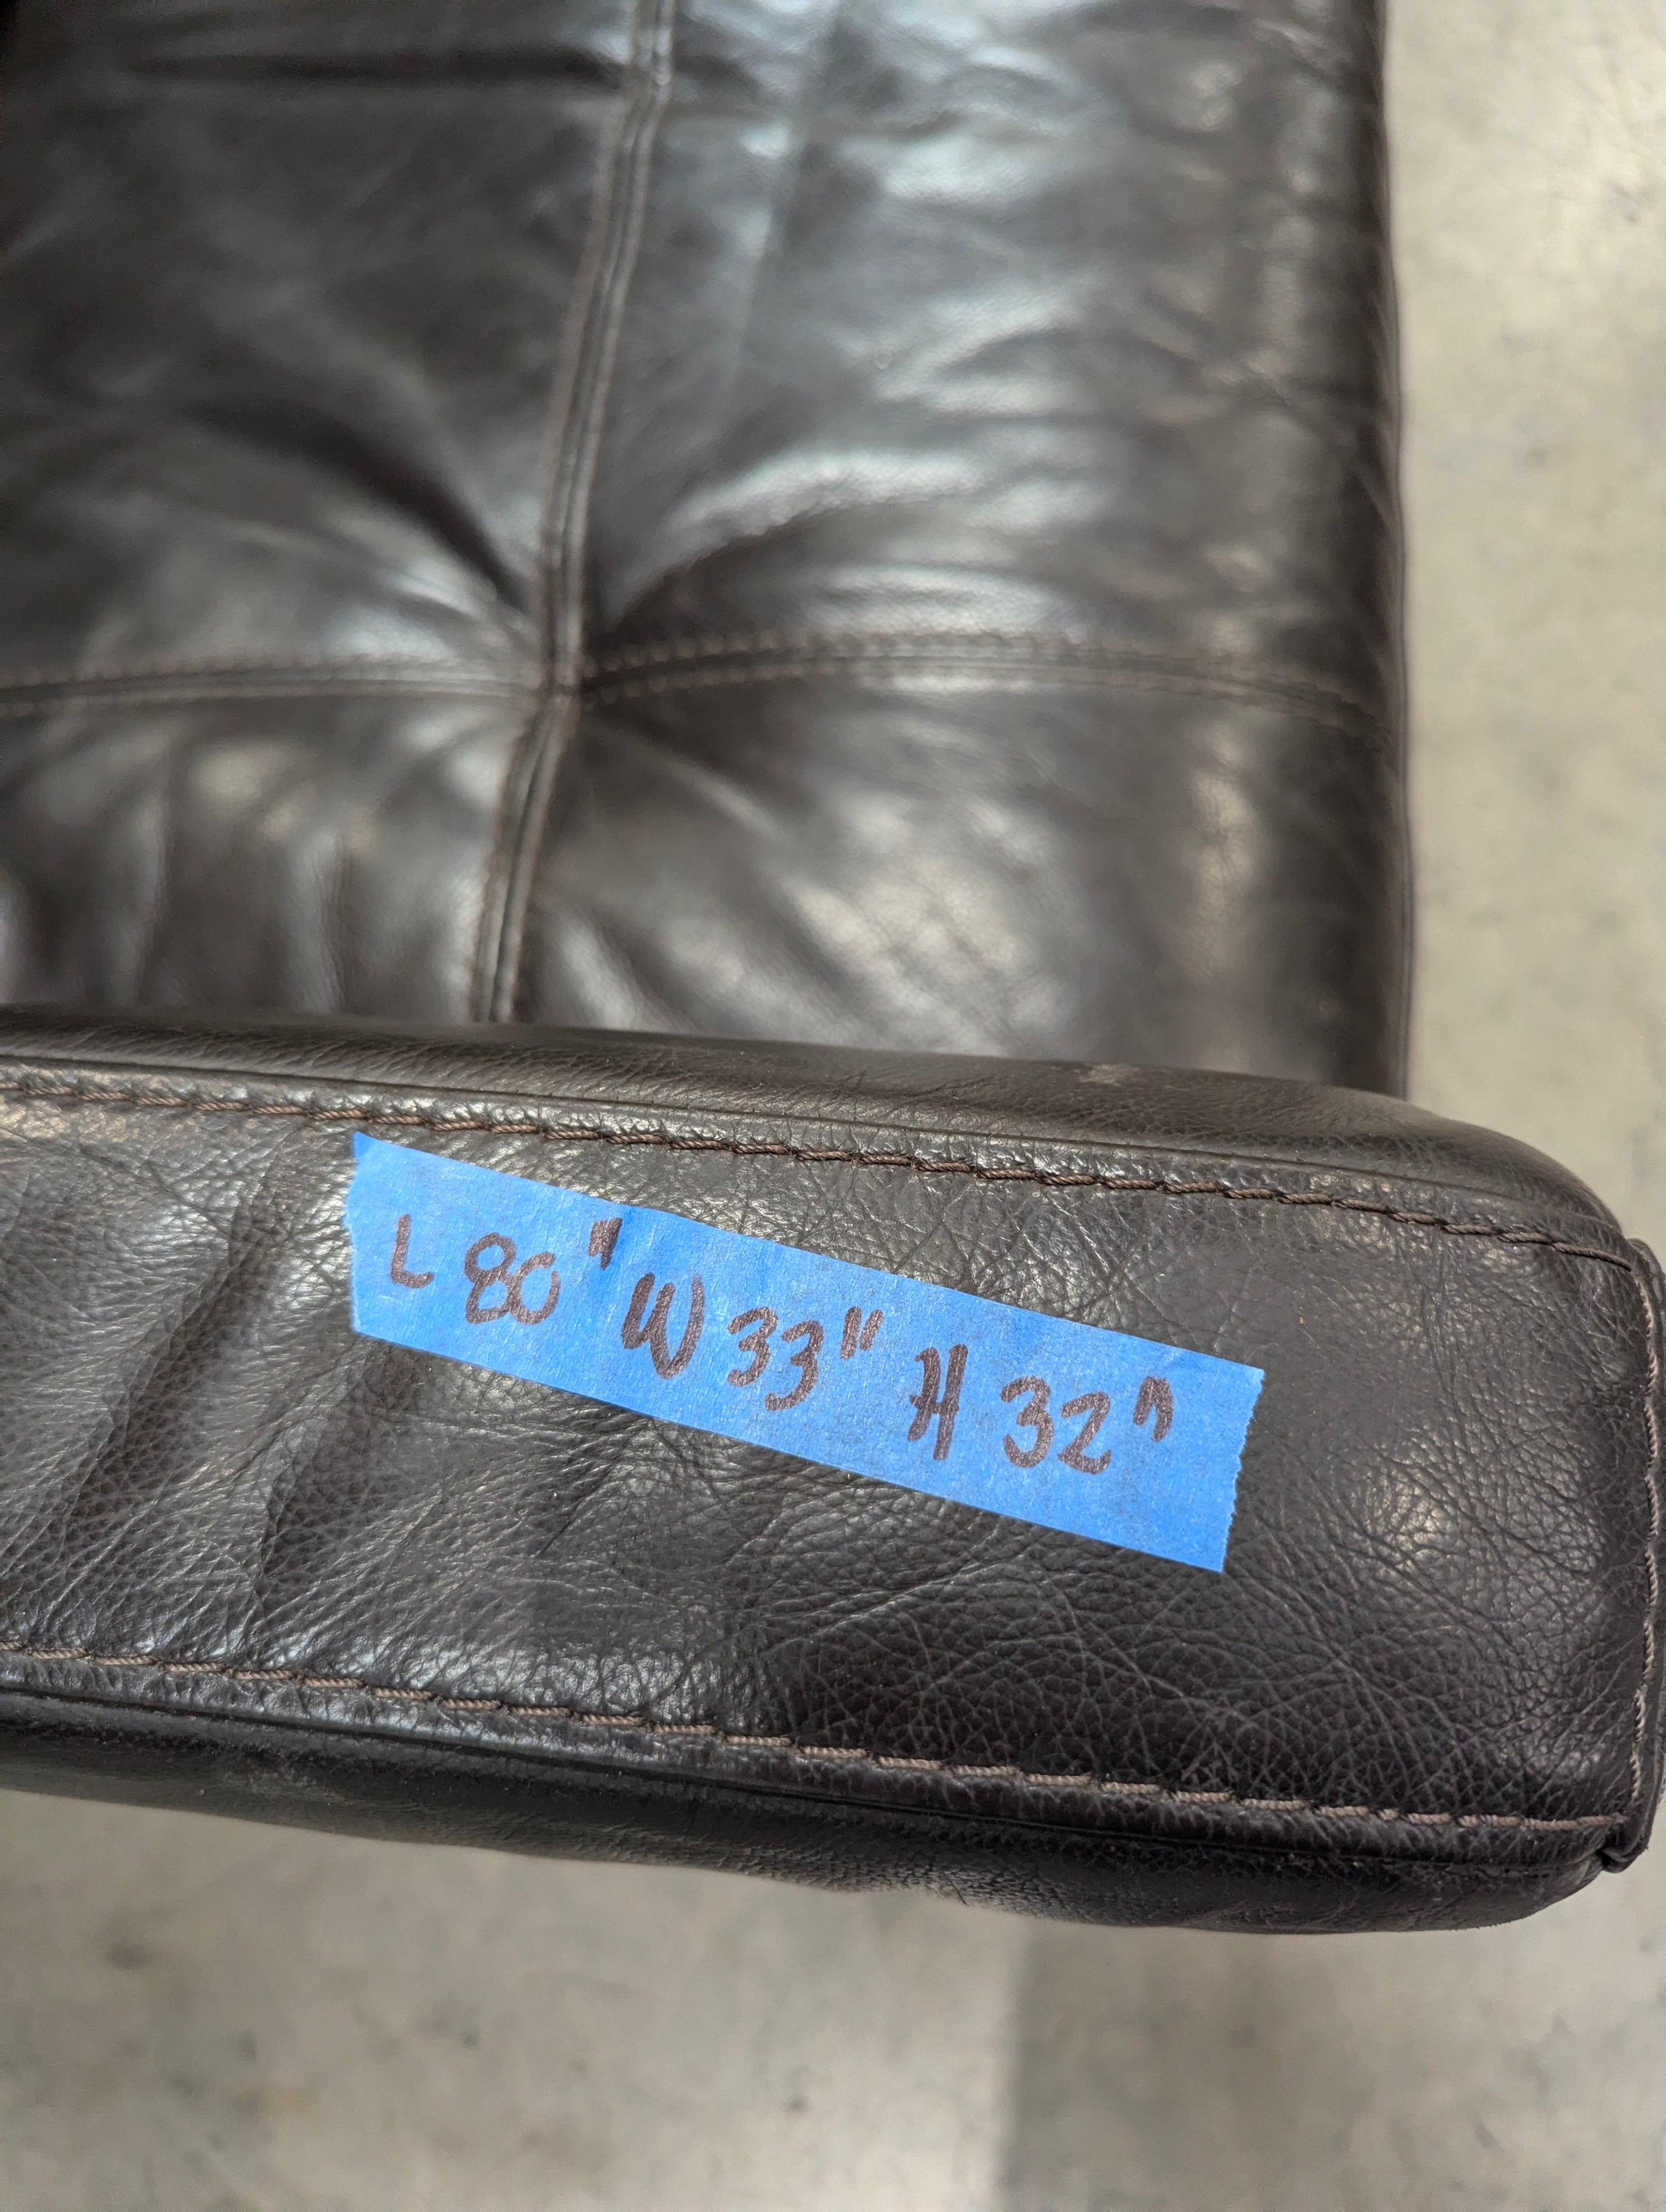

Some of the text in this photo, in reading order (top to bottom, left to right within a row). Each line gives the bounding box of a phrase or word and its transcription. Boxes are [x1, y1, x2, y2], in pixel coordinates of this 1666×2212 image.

[390, 1214, 1174, 1475] L 80" W 33" H 32"
